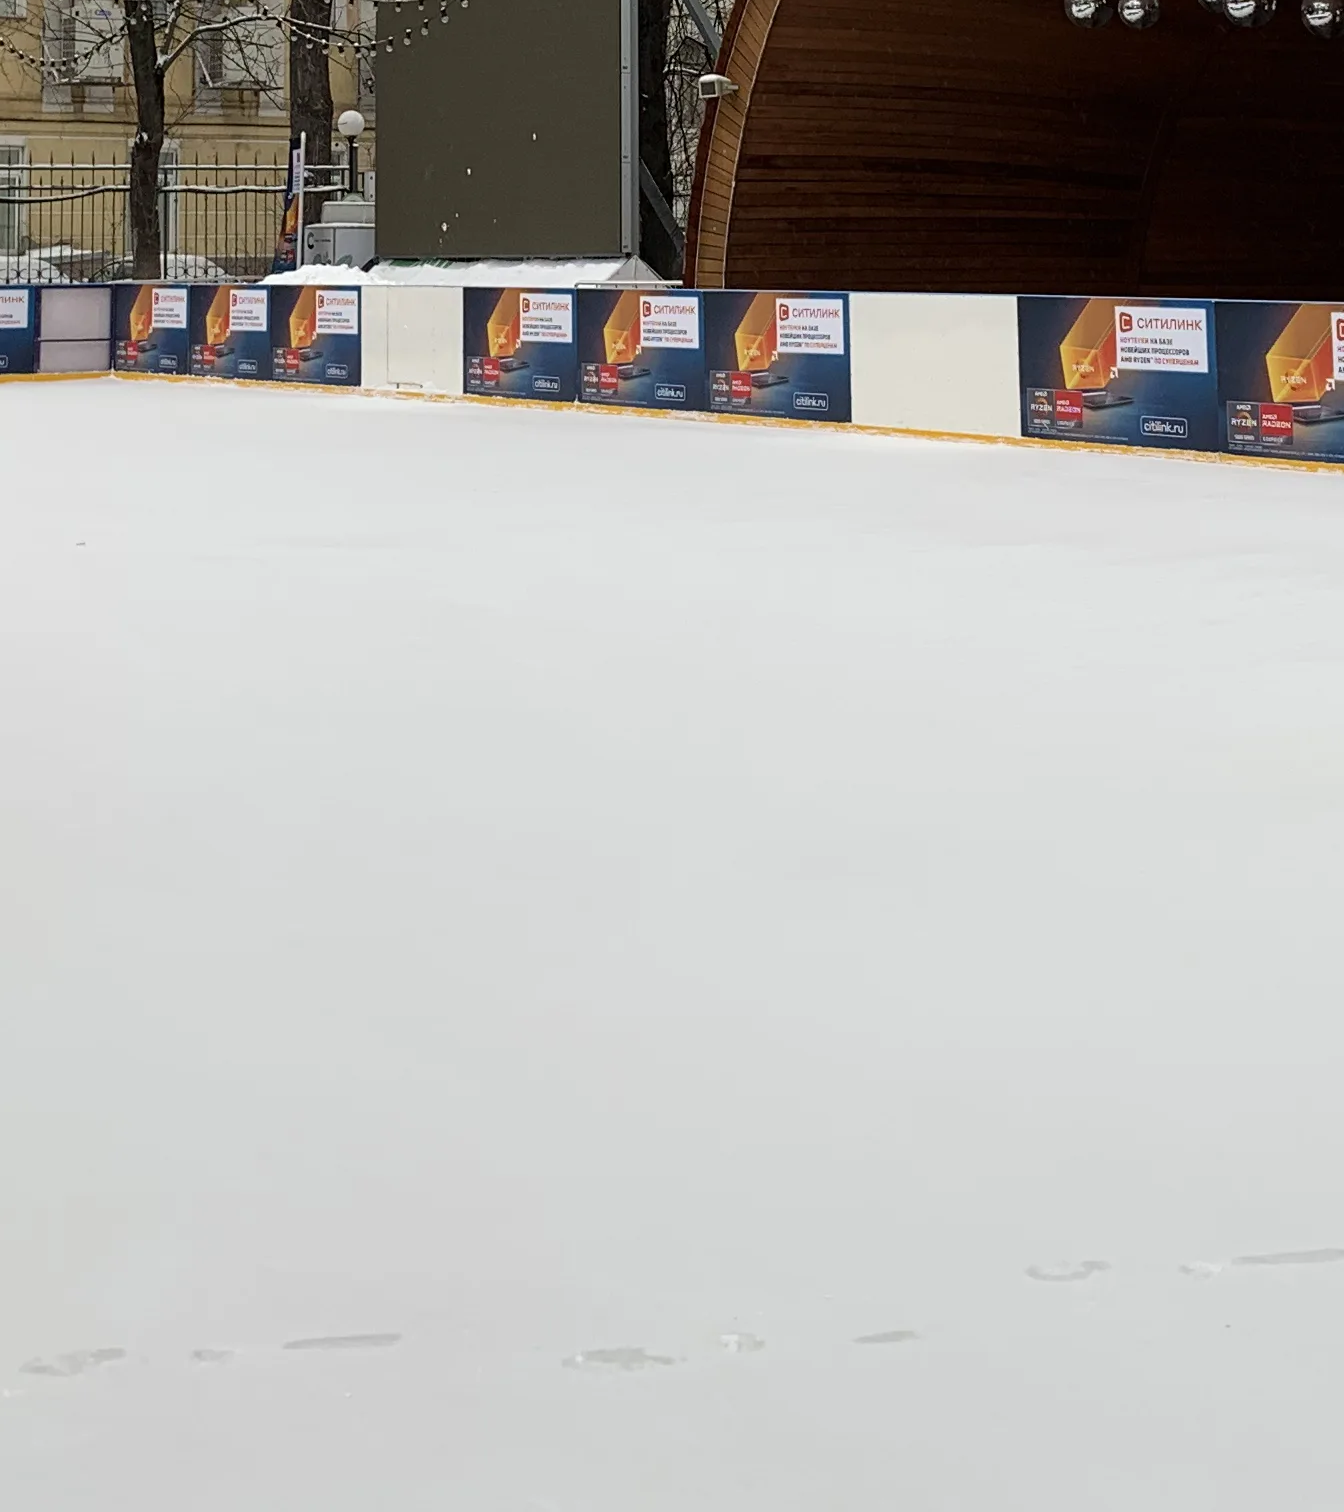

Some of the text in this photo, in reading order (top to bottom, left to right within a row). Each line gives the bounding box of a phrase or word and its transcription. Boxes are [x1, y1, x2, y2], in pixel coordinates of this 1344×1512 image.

[792, 308, 840, 318] СИТИЛИНК
[1137, 317, 1203, 331] СИТИЛИНК
[1144, 420, 1184, 434] citilink.ru
